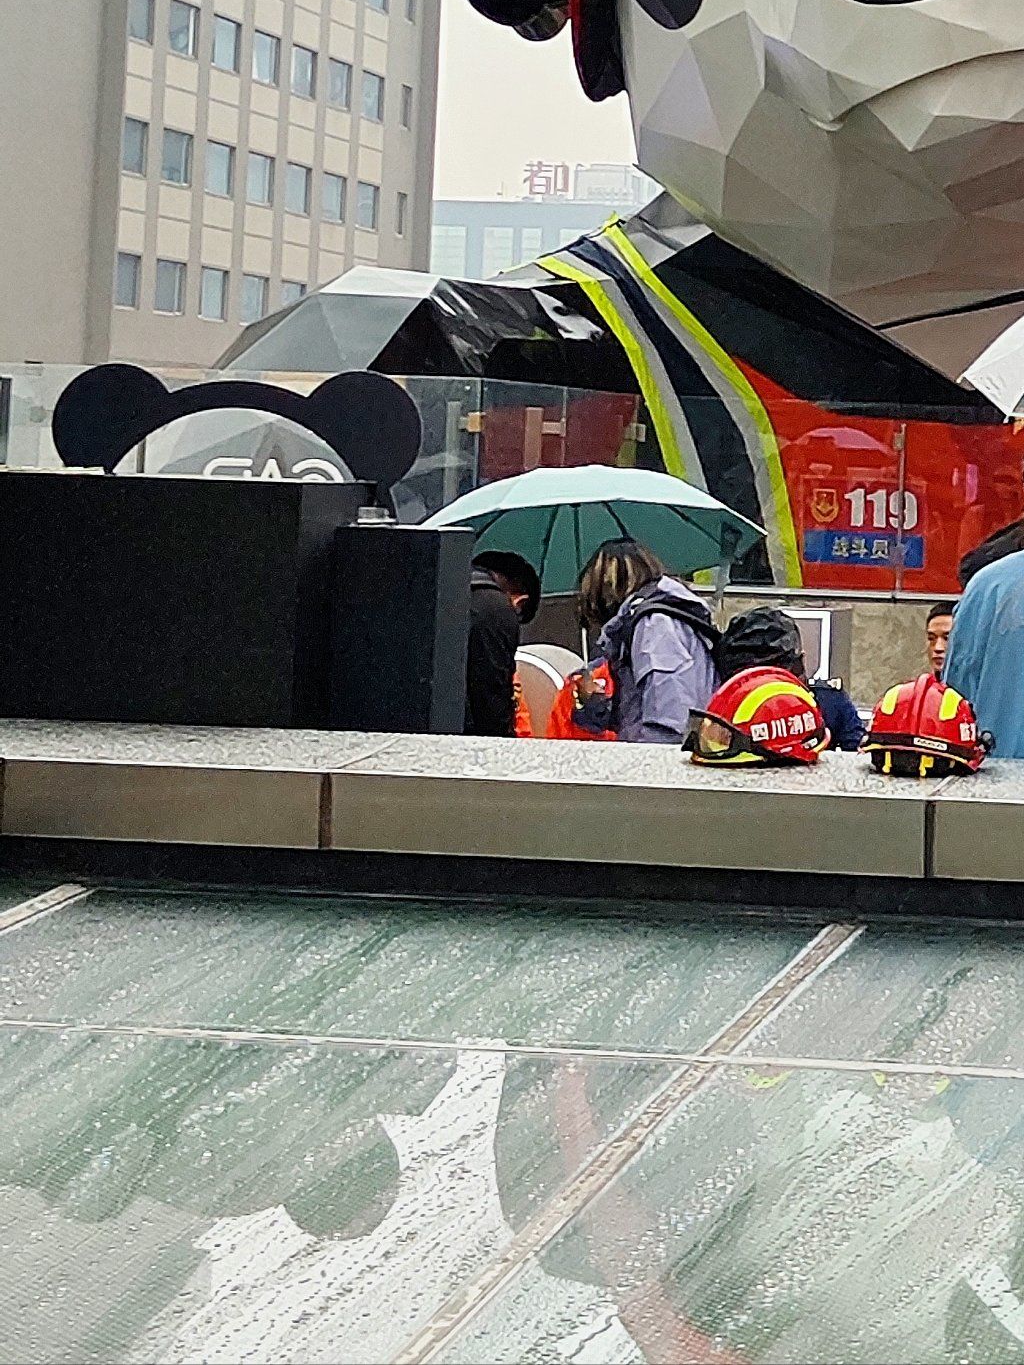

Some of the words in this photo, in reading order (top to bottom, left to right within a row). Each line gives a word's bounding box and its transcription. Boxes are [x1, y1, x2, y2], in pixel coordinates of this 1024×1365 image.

[523, 161, 569, 196] 都
[844, 488, 918, 530] 119
[750, 711, 816, 742] 四川消防
